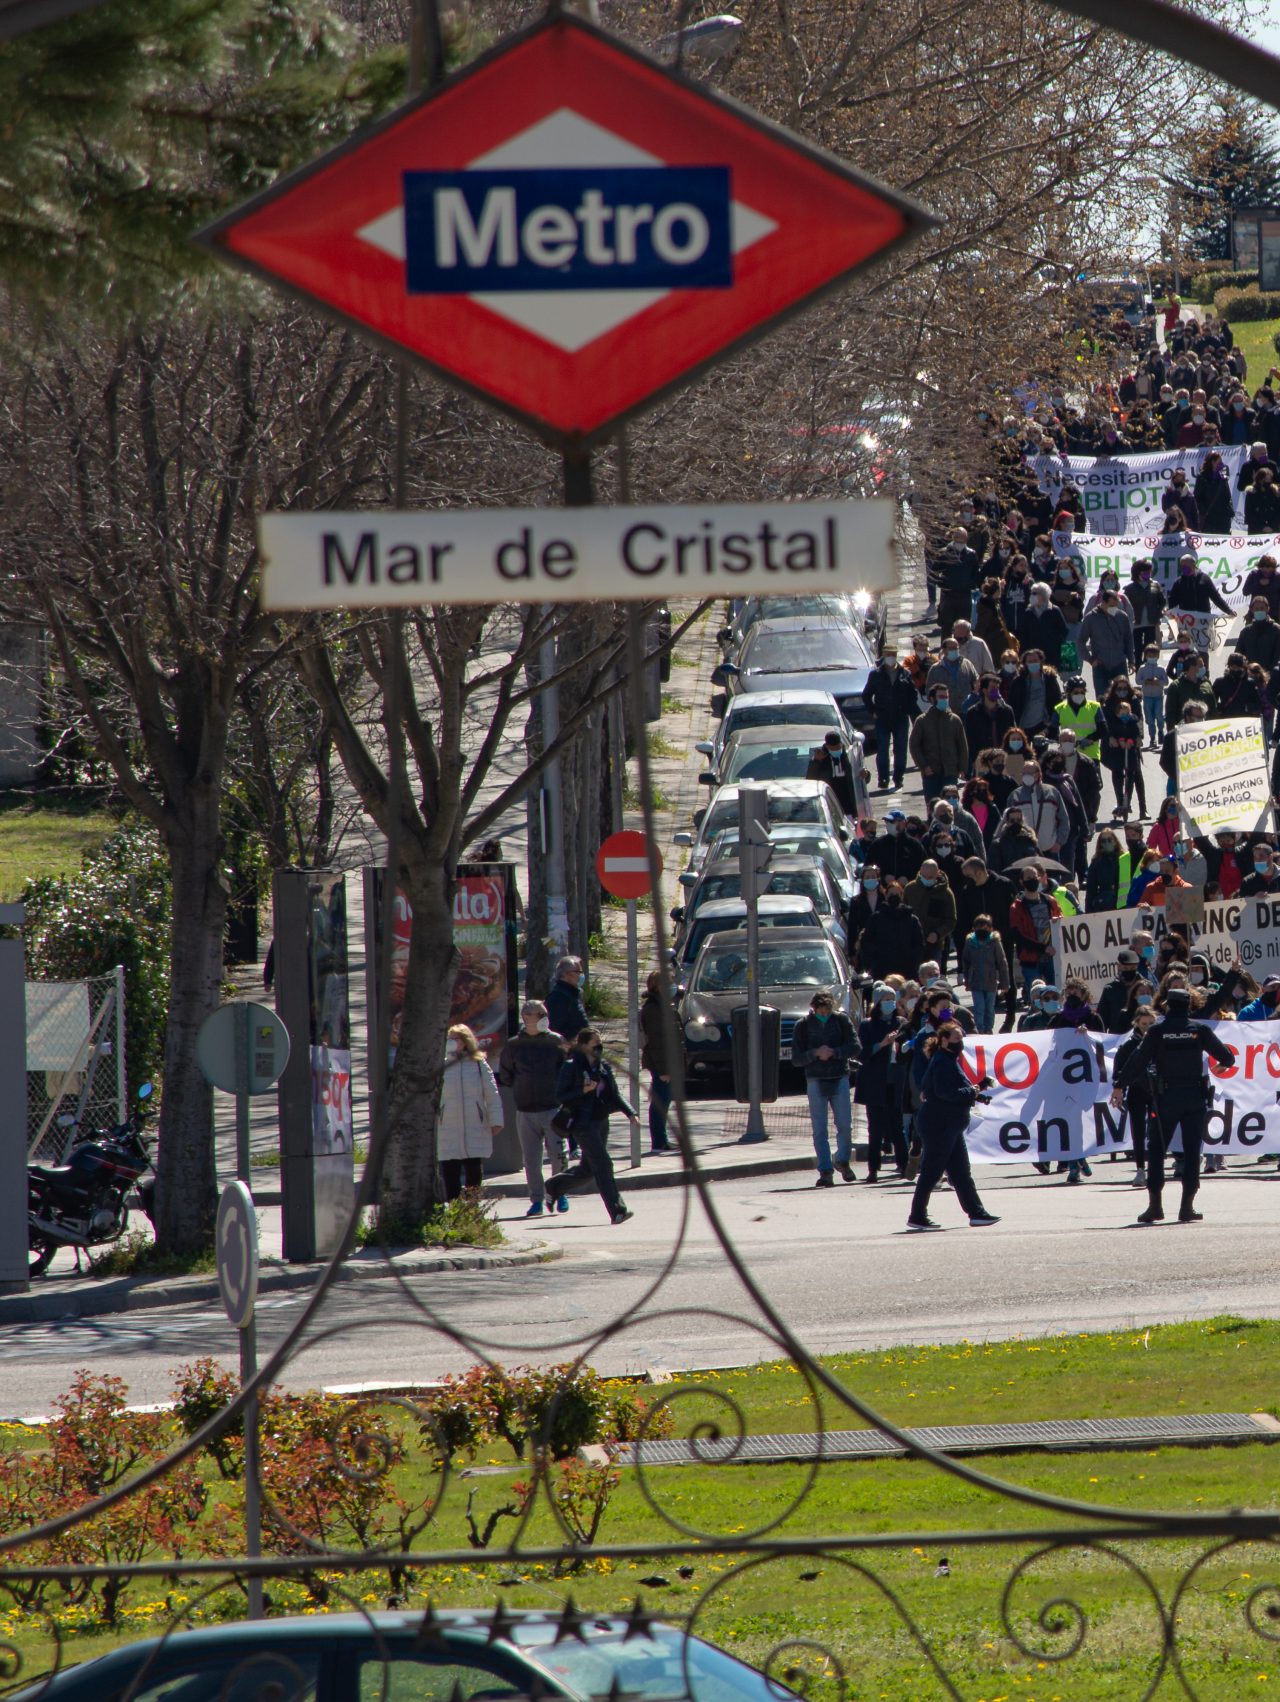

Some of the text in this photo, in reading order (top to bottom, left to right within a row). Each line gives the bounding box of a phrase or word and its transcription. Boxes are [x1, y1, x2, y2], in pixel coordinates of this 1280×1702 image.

[433, 186, 710, 270] Metro
[1046, 467, 1186, 488] Necesitamo
[320, 517, 841, 586] Mar de Cristal
[1181, 726, 1259, 755] USO PARA EL
[1189, 777, 1264, 805] NO AL PARKING
[1207, 790, 1252, 809] DE PAGO
[1061, 921, 1091, 954] NO
[1103, 917, 1131, 949] AL
[1216, 945, 1232, 964] de
[959, 1042, 1040, 1091] NO
[1062, 1041, 1108, 1084] al
[998, 1113, 1071, 1154] en
[1201, 1099, 1267, 1146] de
